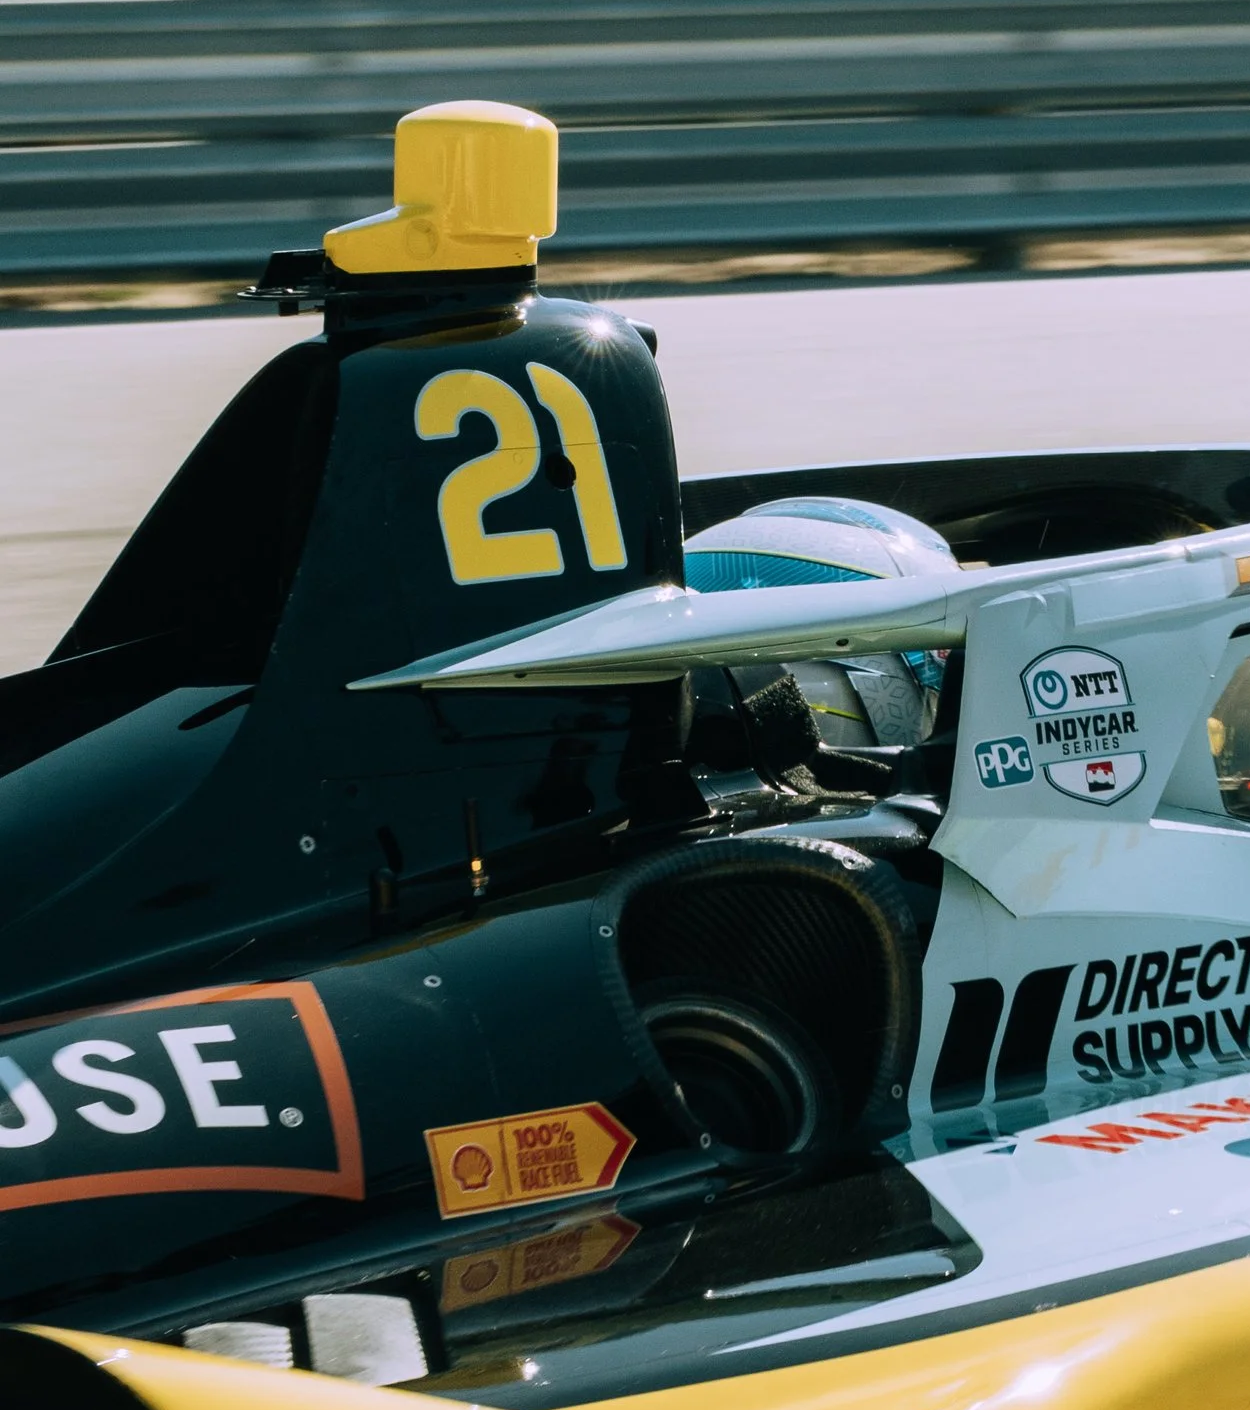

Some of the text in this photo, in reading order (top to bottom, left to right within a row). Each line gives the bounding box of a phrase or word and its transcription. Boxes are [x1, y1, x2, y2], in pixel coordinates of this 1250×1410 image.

[414, 361, 628, 586] 21
[1070, 670, 1119, 698] NTT
[1035, 710, 1138, 745] INDYCAR
[977, 742, 1032, 783] PPG
[1062, 737, 1120, 756] SERIES
[512, 1120, 575, 1150] 100%
